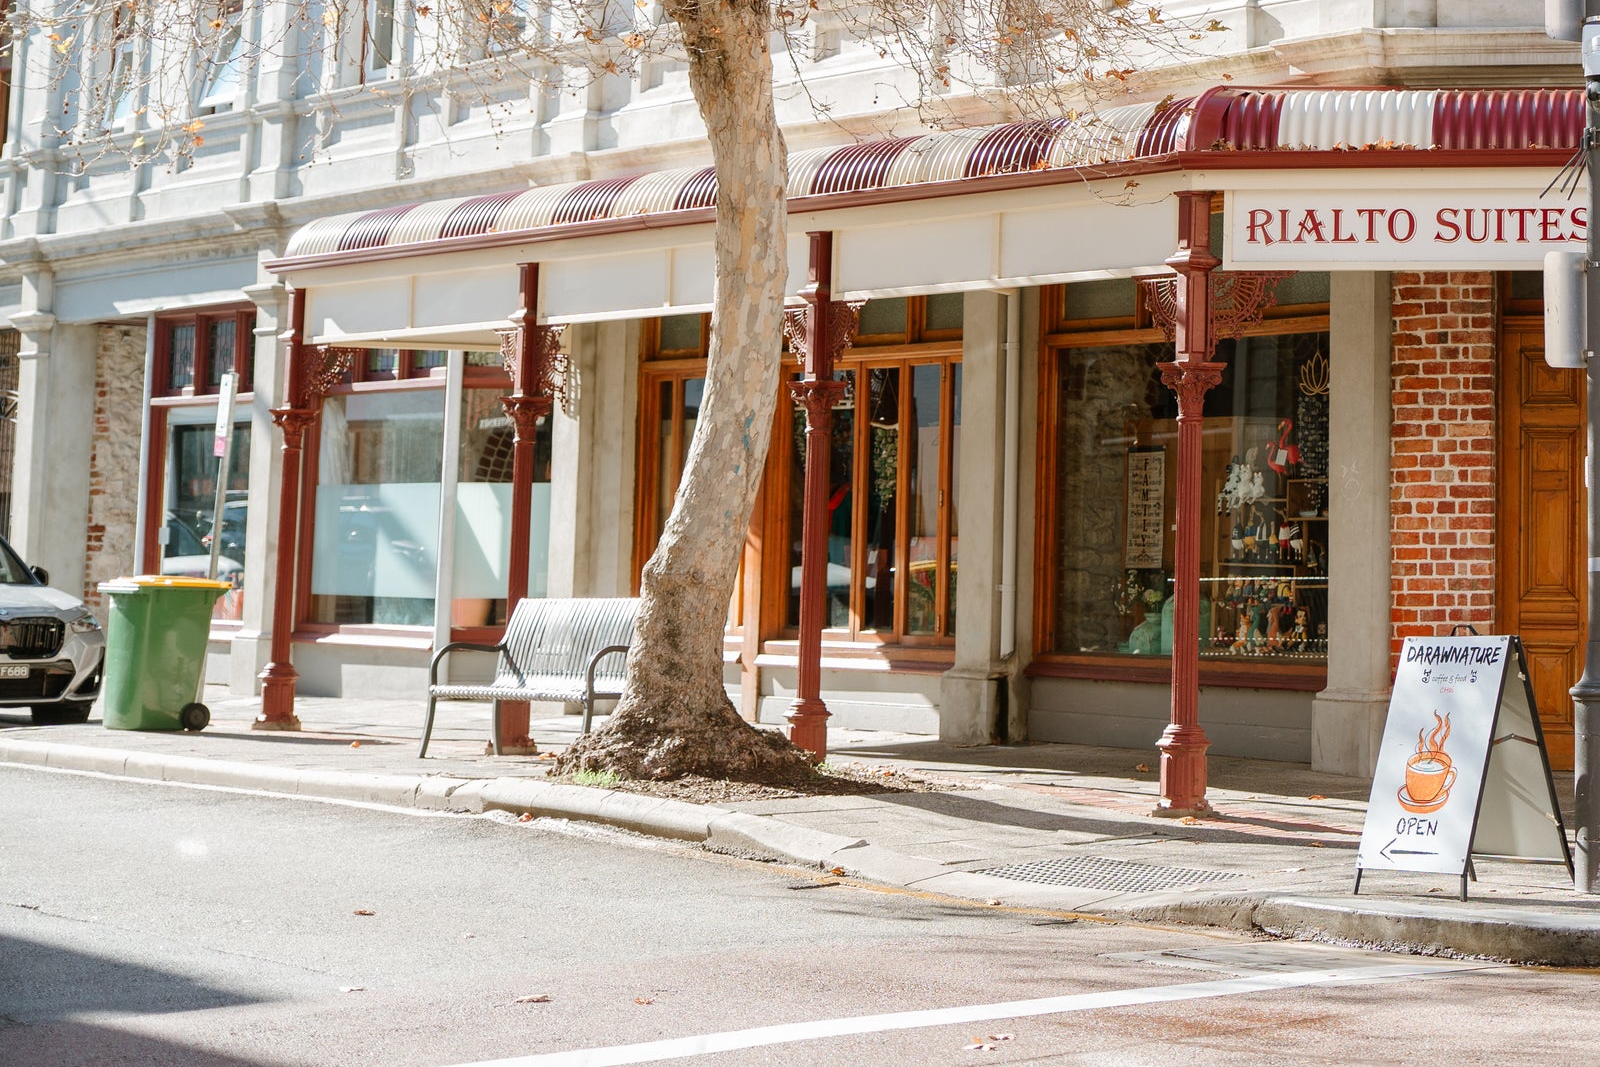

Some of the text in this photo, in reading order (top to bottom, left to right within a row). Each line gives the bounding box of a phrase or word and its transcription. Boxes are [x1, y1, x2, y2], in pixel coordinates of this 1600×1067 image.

[1246, 207, 1417, 244] RIALTO
[1434, 207, 1587, 243] SUITES
[1407, 645, 1502, 666] DARAWNATURE
[1396, 816, 1438, 836] OPEN
